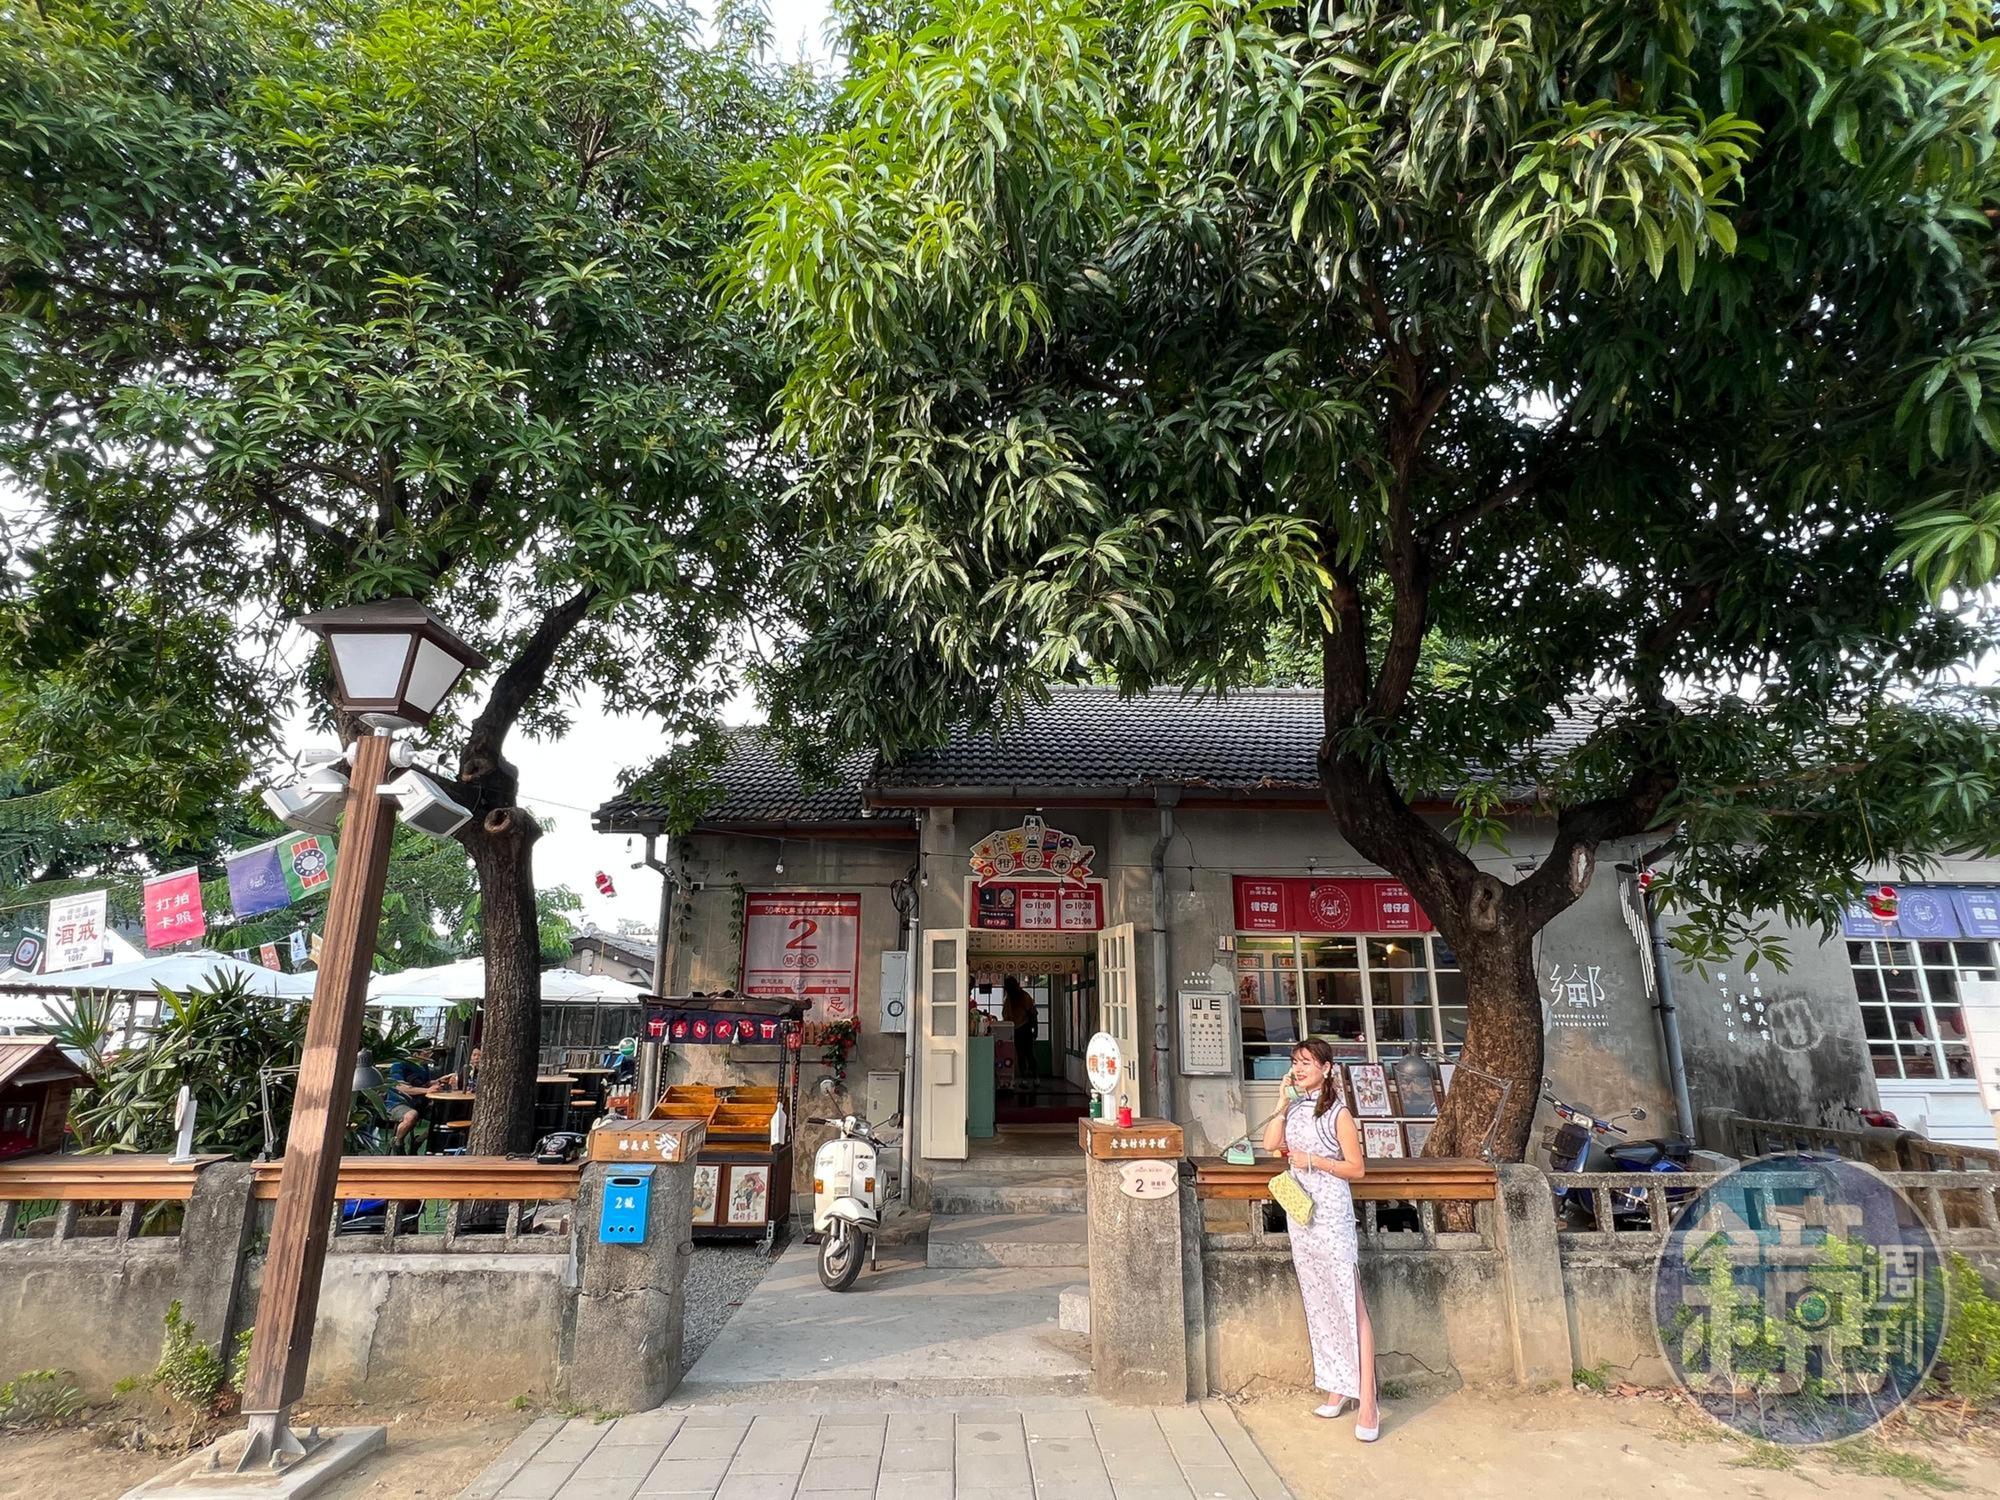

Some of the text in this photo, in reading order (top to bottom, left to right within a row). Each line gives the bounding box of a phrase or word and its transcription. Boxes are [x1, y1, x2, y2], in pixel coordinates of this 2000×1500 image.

[1034, 902, 1051, 910] 11:00
[1033, 917, 1051, 925] 19:00
[785, 918, 818, 950] 2
[1135, 1178, 1144, 1193] 2
